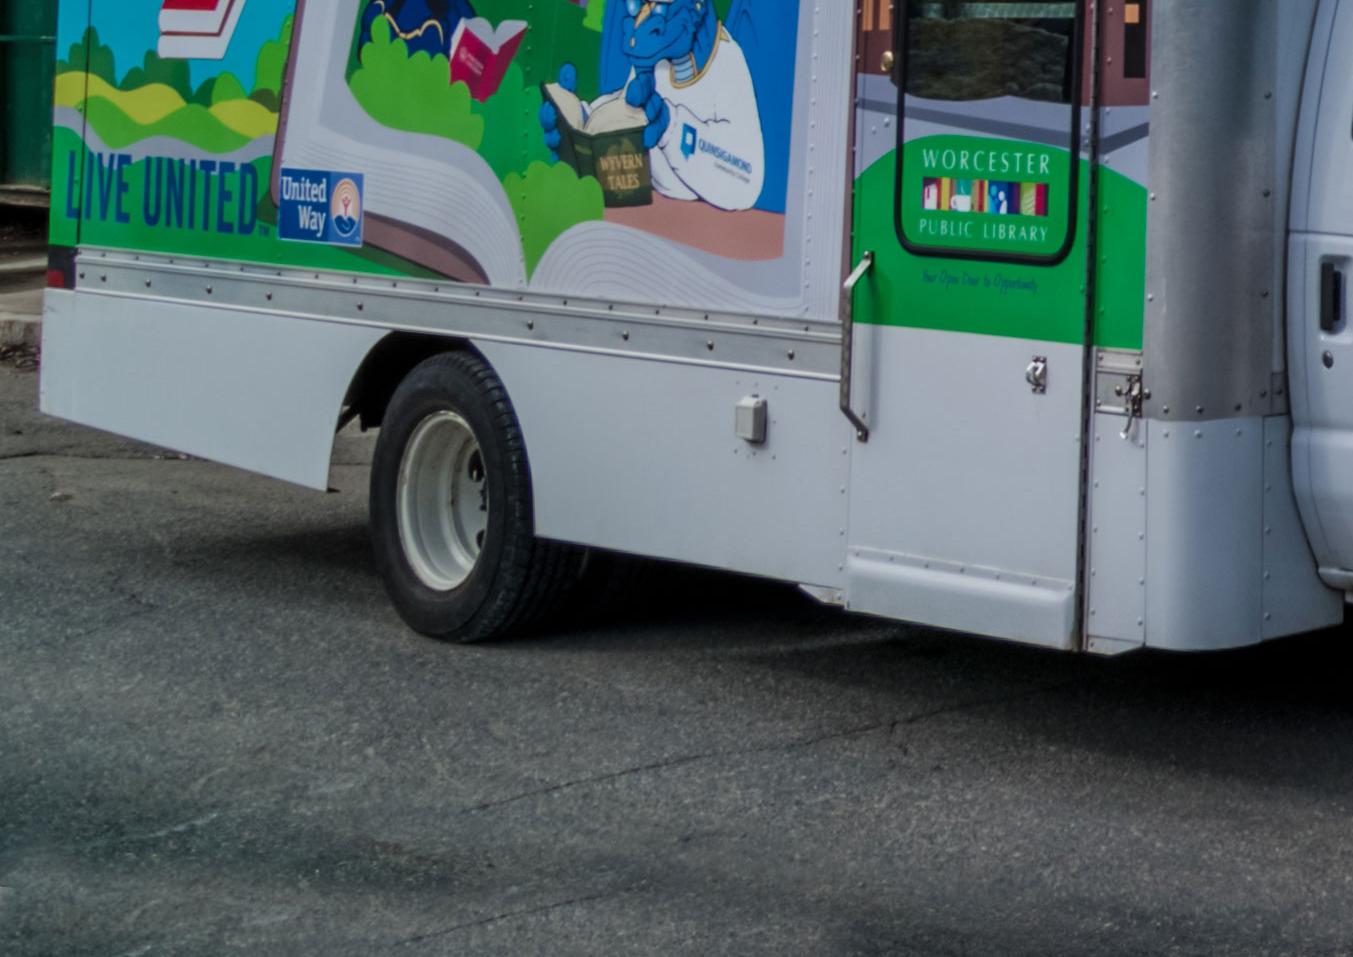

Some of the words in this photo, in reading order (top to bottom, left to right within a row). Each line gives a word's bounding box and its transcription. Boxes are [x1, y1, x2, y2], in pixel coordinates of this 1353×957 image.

[599, 152, 643, 172] WYVERN
[922, 148, 1049, 175] WORCESTER
[65, 150, 132, 224] LIVE
[142, 155, 258, 235] UNITED
[281, 176, 327, 203] United
[607, 173, 640, 191] TALES
[298, 205, 326, 238] Way
[919, 218, 974, 238] PUBLIC
[983, 222, 1049, 242] LIBRARY
